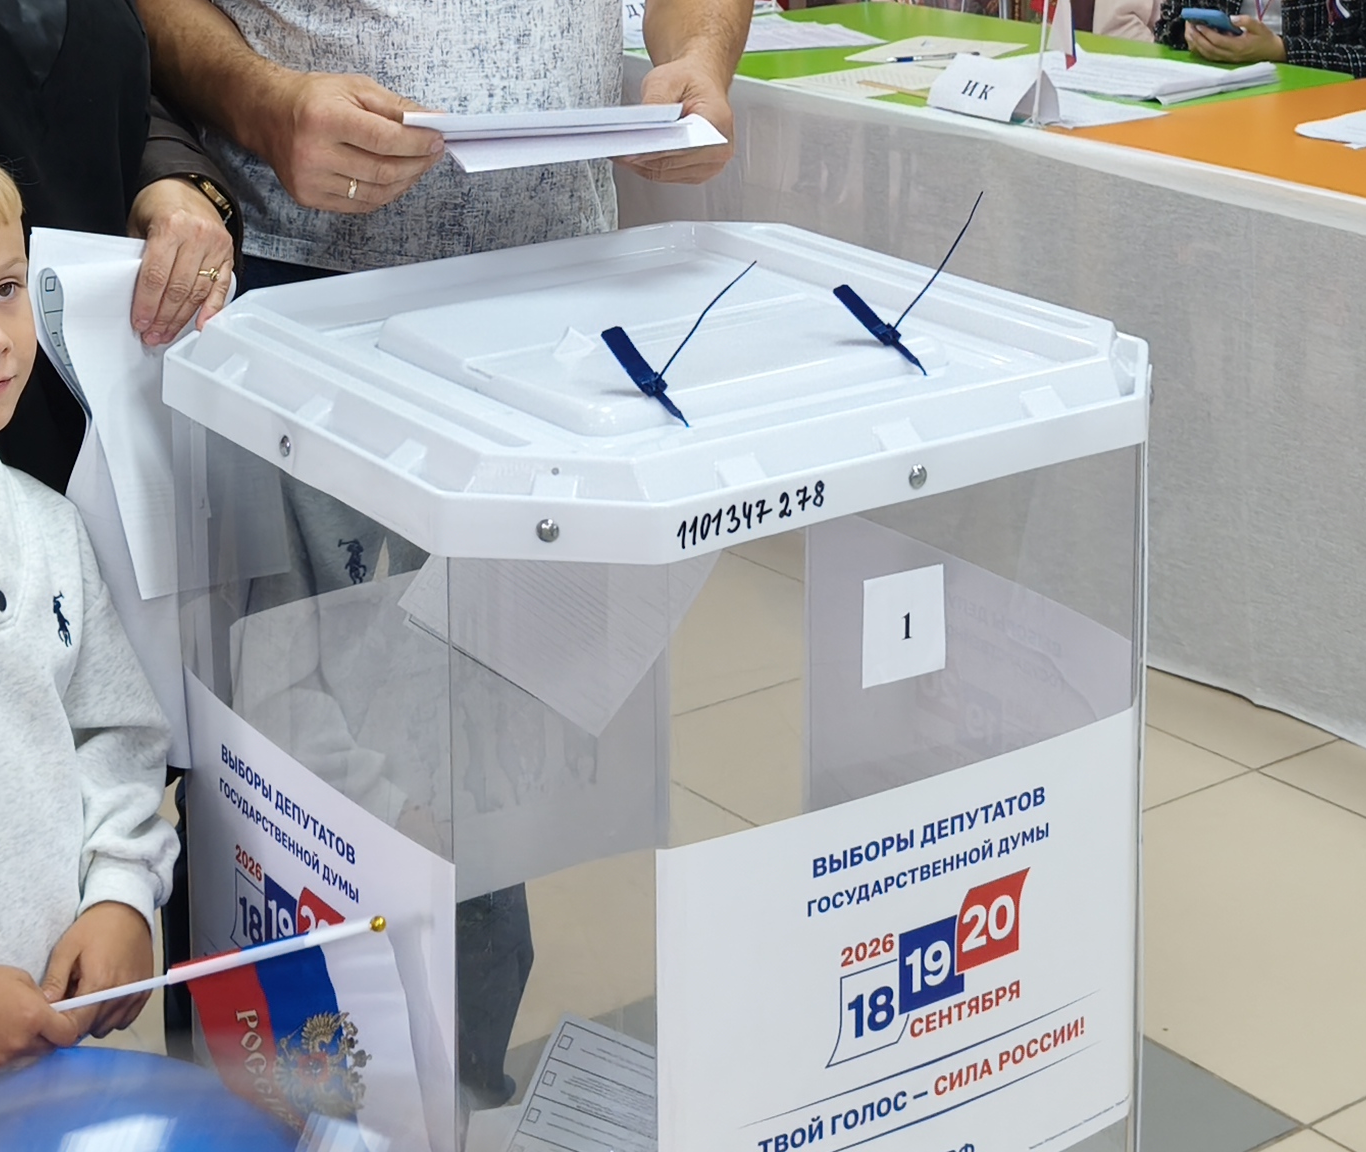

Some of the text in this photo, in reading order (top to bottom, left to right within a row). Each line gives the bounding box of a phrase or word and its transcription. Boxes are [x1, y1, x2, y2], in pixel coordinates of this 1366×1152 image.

[901, 612, 912, 640] 1
[219, 777, 359, 903] ГОСУДАРСТВЕННОЙ ДУМЫ
[221, 743, 356, 865] ВЫБОРЫ ДЕПУТАТОВ
[812, 786, 1046, 879] ВЫБОРЫ ДЕПУТАТОВ
[235, 844, 262, 882] 2026
[806, 822, 1050, 917] ГОСУДАРСТВЕННОЙ ДУМЫ
[300, 905, 331, 933] 2
[840, 932, 895, 968] 2026
[846, 894, 1016, 1039] 18 19 20
[909, 979, 1022, 1039] СЕНТЯБРЯ
[830, 1091, 907, 1136] ГОЛОС
[933, 1058, 993, 1097] СИЛА
[998, 1016, 1086, 1072] РОССИИ!
